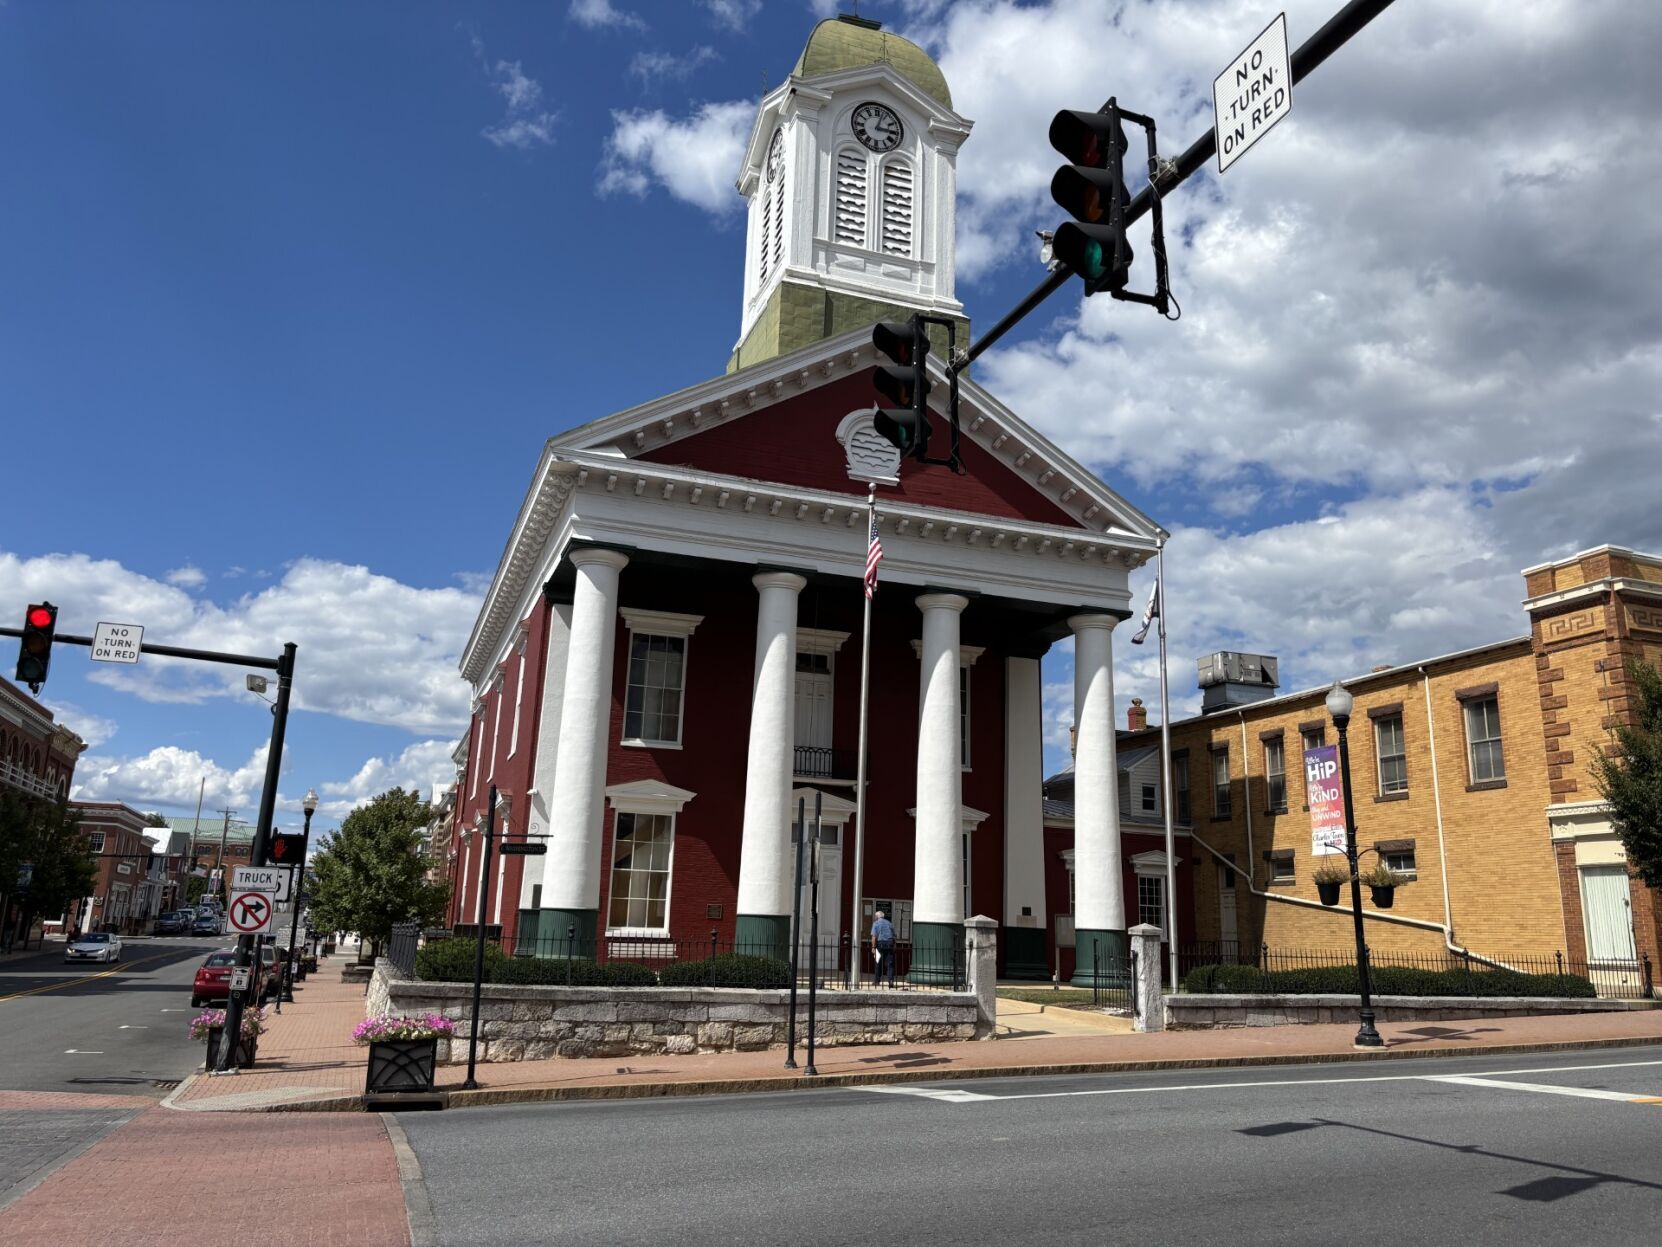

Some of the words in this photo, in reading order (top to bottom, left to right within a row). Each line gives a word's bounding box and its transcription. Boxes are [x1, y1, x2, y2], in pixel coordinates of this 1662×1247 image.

[1236, 50, 1262, 87] NO
[1229, 66, 1273, 119] TURN
[1224, 123, 1245, 154] ON
[1252, 87, 1285, 130] RED
[111, 628, 128, 636] NO
[104, 638, 132, 648] TURN
[115, 650, 135, 658] RED
[239, 872, 272, 883] TRUCK
